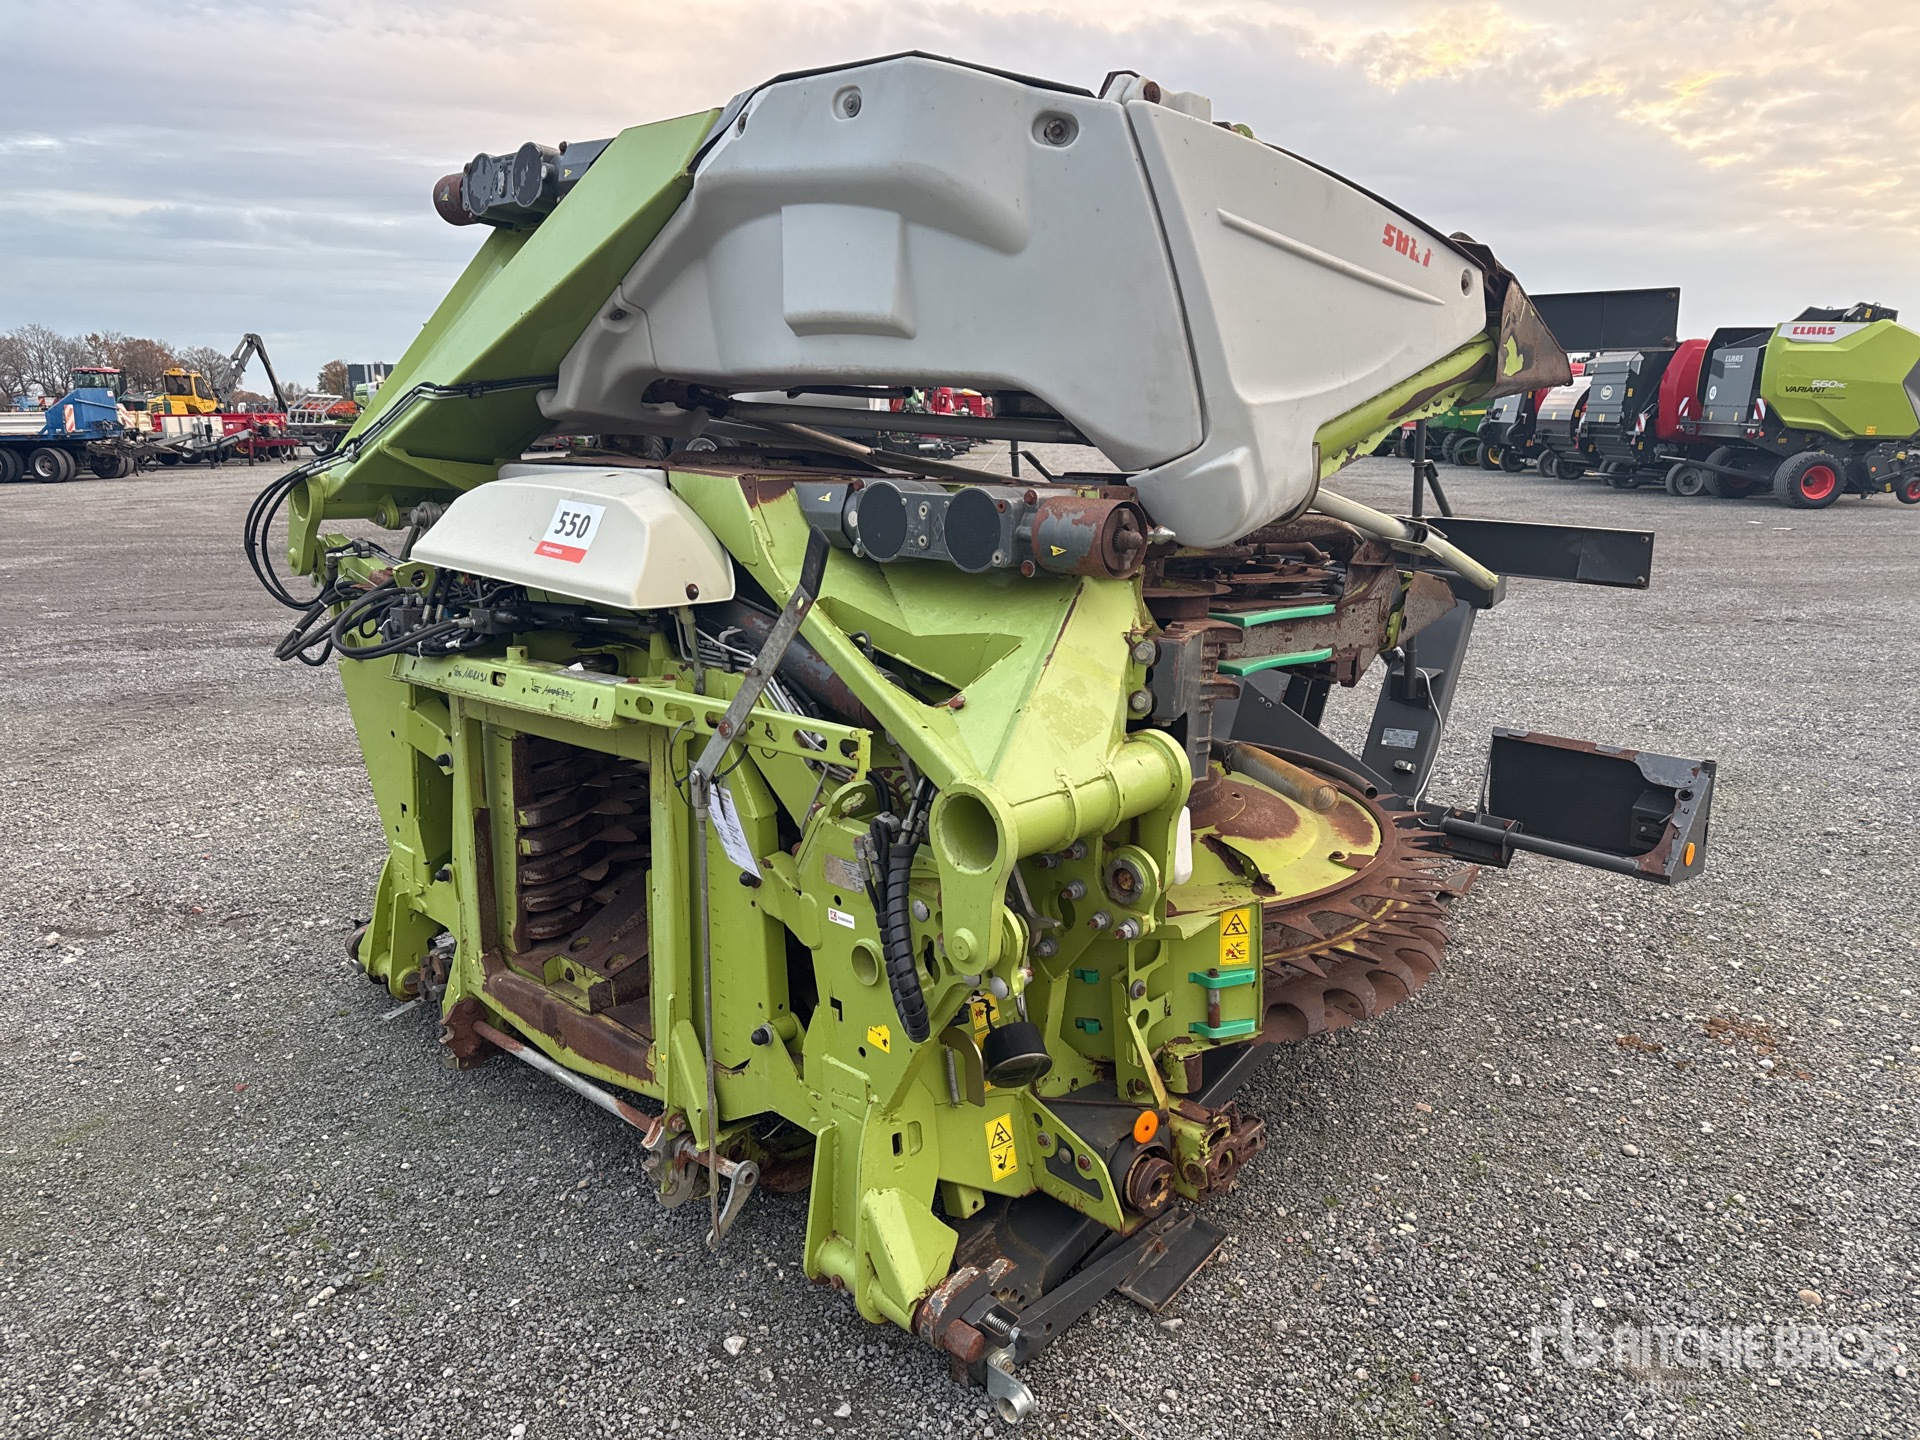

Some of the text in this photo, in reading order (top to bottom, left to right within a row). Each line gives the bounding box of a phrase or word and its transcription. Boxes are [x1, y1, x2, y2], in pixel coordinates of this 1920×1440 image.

[1792, 326, 1836, 335] CLAAS
[1725, 354, 1744, 363] CLAAS
[554, 510, 591, 539] 550
